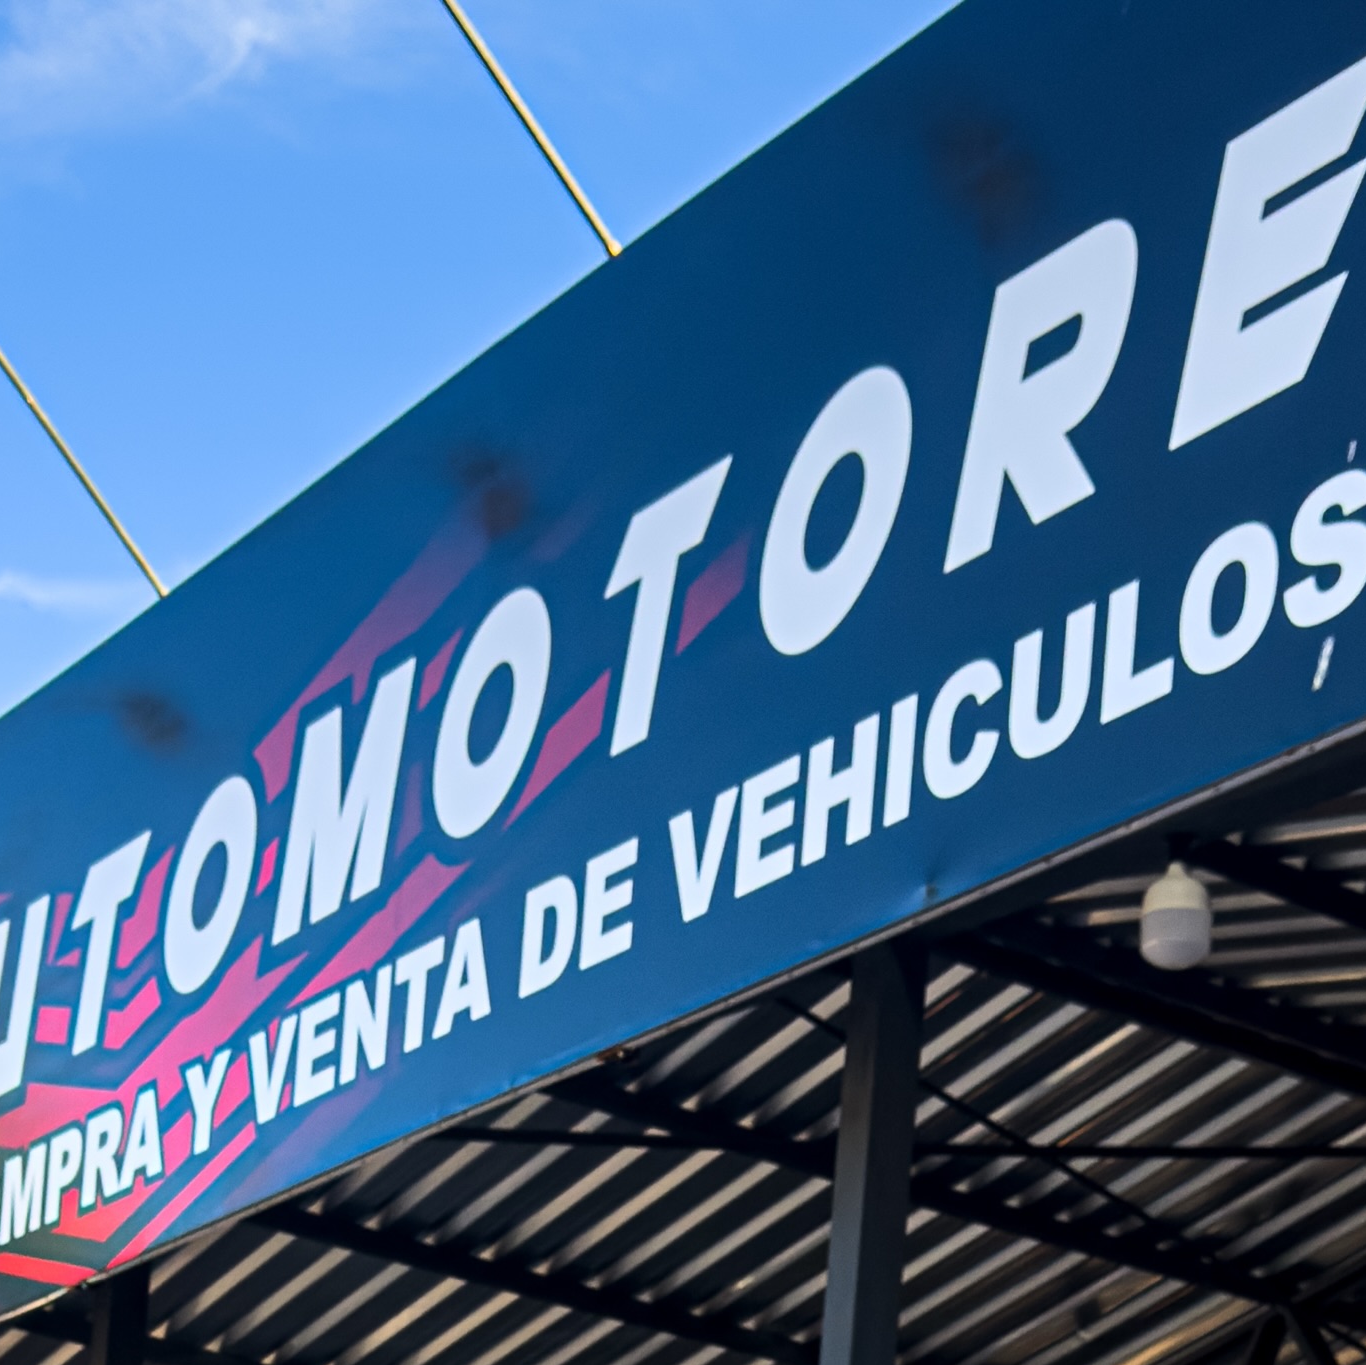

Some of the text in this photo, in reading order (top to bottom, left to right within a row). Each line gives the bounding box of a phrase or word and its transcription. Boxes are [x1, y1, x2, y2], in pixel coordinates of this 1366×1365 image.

[185, 1050, 233, 1155] Y
[250, 918, 491, 1124] VENTA
[519, 837, 639, 999] DE
